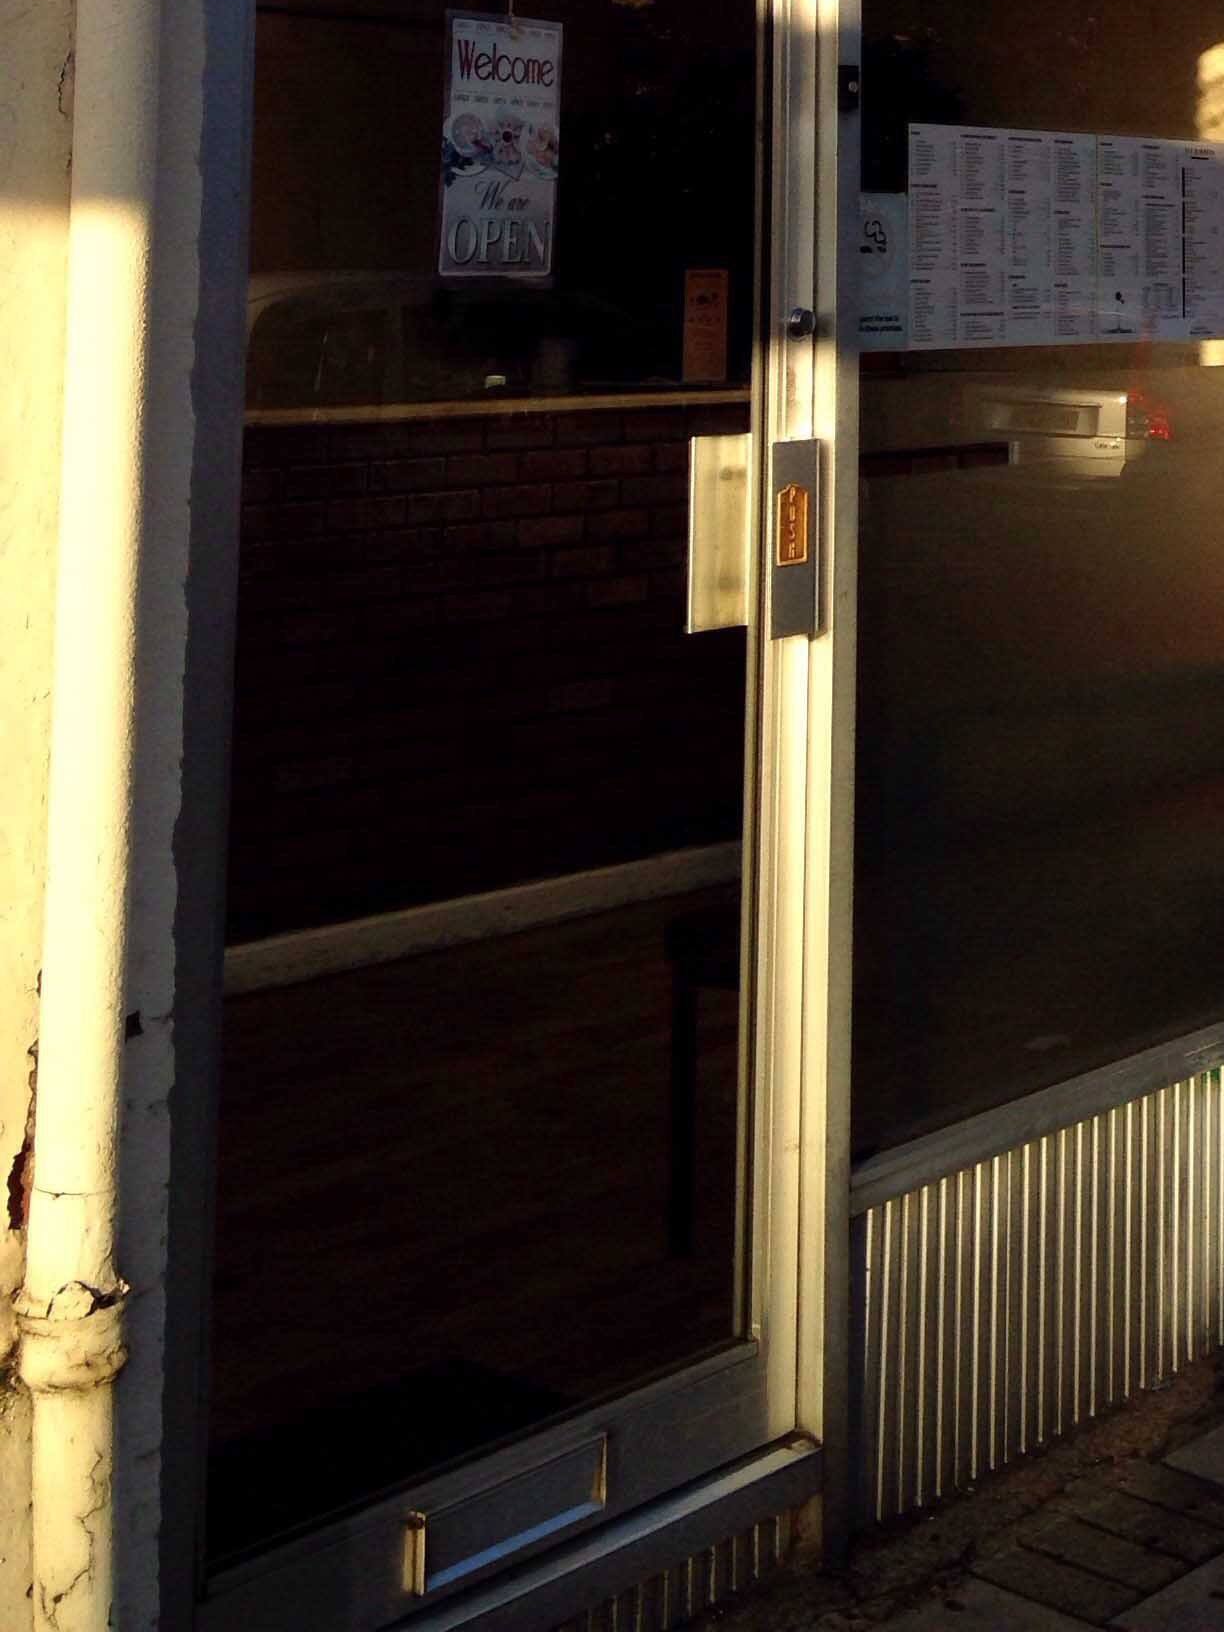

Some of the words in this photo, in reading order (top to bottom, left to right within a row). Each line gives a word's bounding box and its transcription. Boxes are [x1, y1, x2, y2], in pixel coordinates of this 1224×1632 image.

[457, 38, 555, 87] Welcome
[447, 216, 552, 265] OPEN
[787, 485, 798, 560] PUSH
